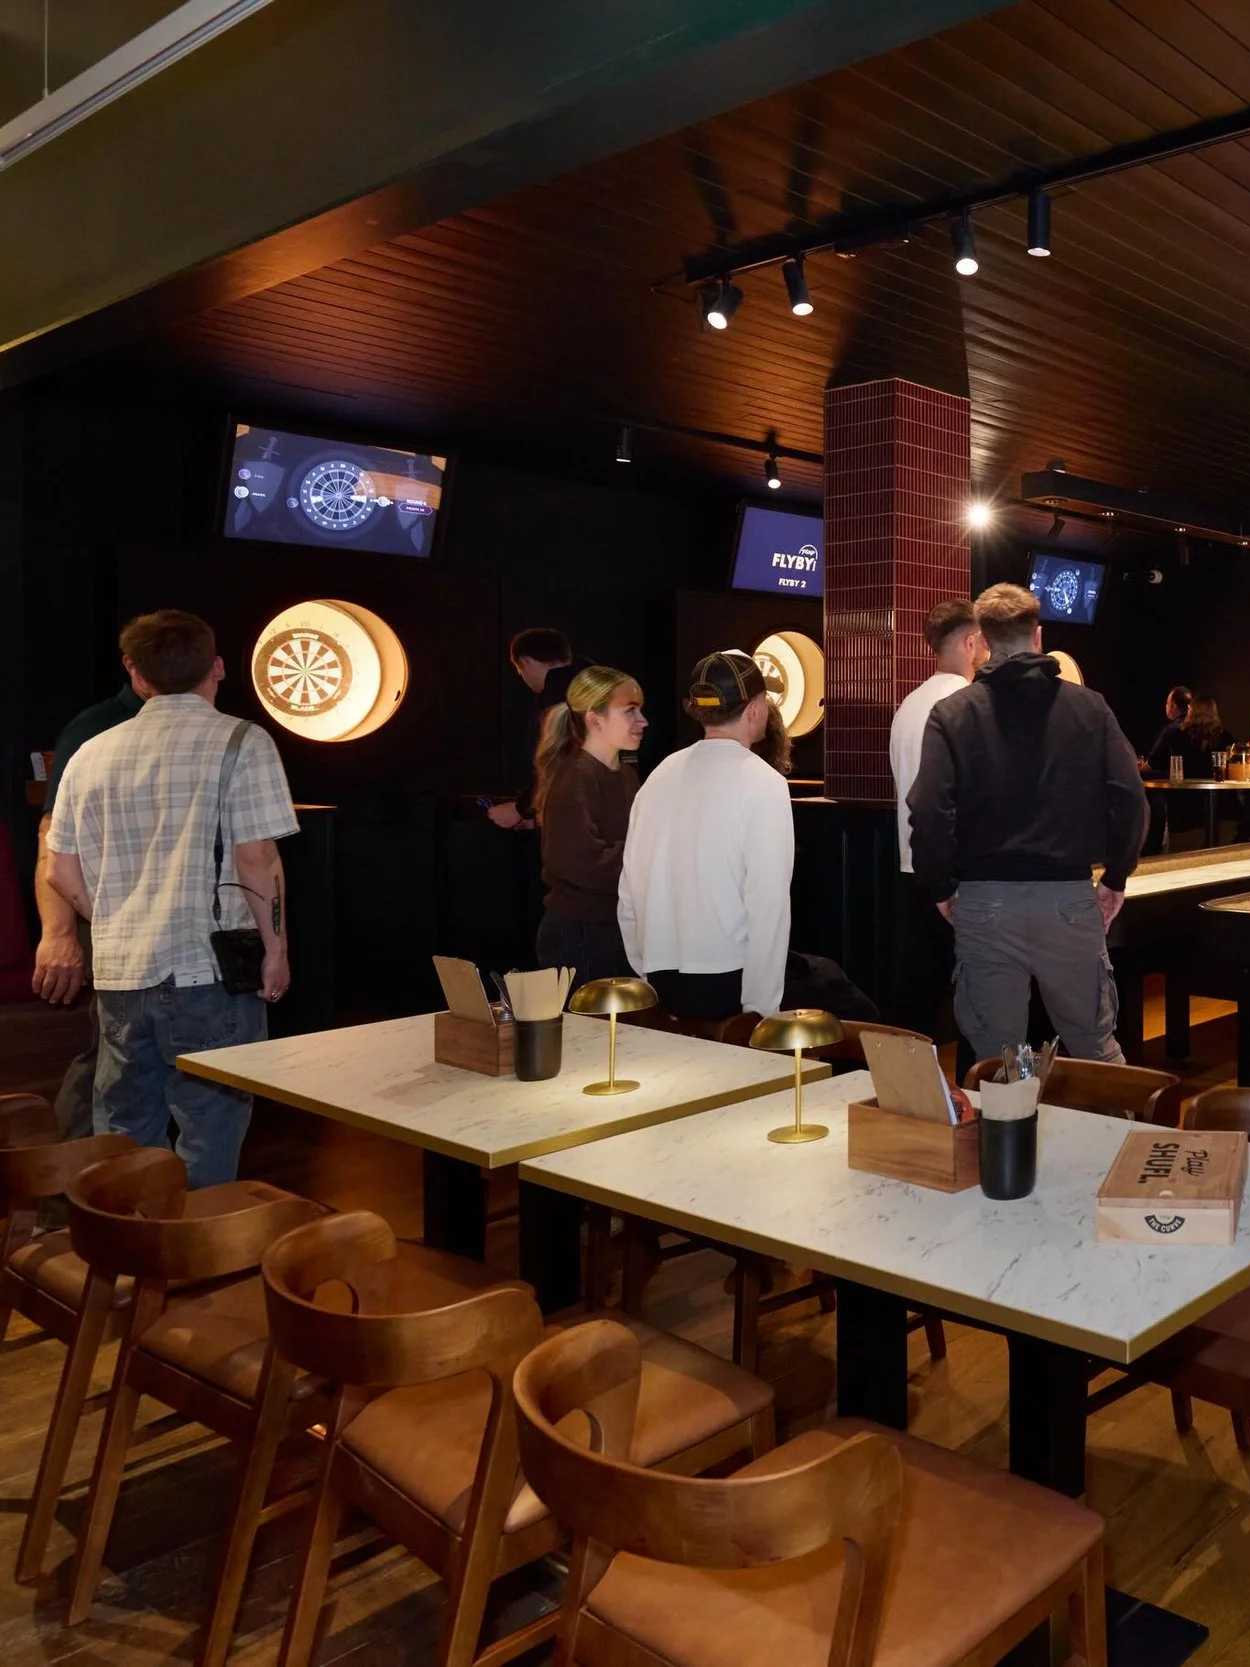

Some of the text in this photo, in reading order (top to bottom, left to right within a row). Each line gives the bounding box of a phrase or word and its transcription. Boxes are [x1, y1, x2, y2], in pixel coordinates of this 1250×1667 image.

[778, 578, 807, 588] FLYBY 2
[1181, 1150, 1209, 1176] Play
